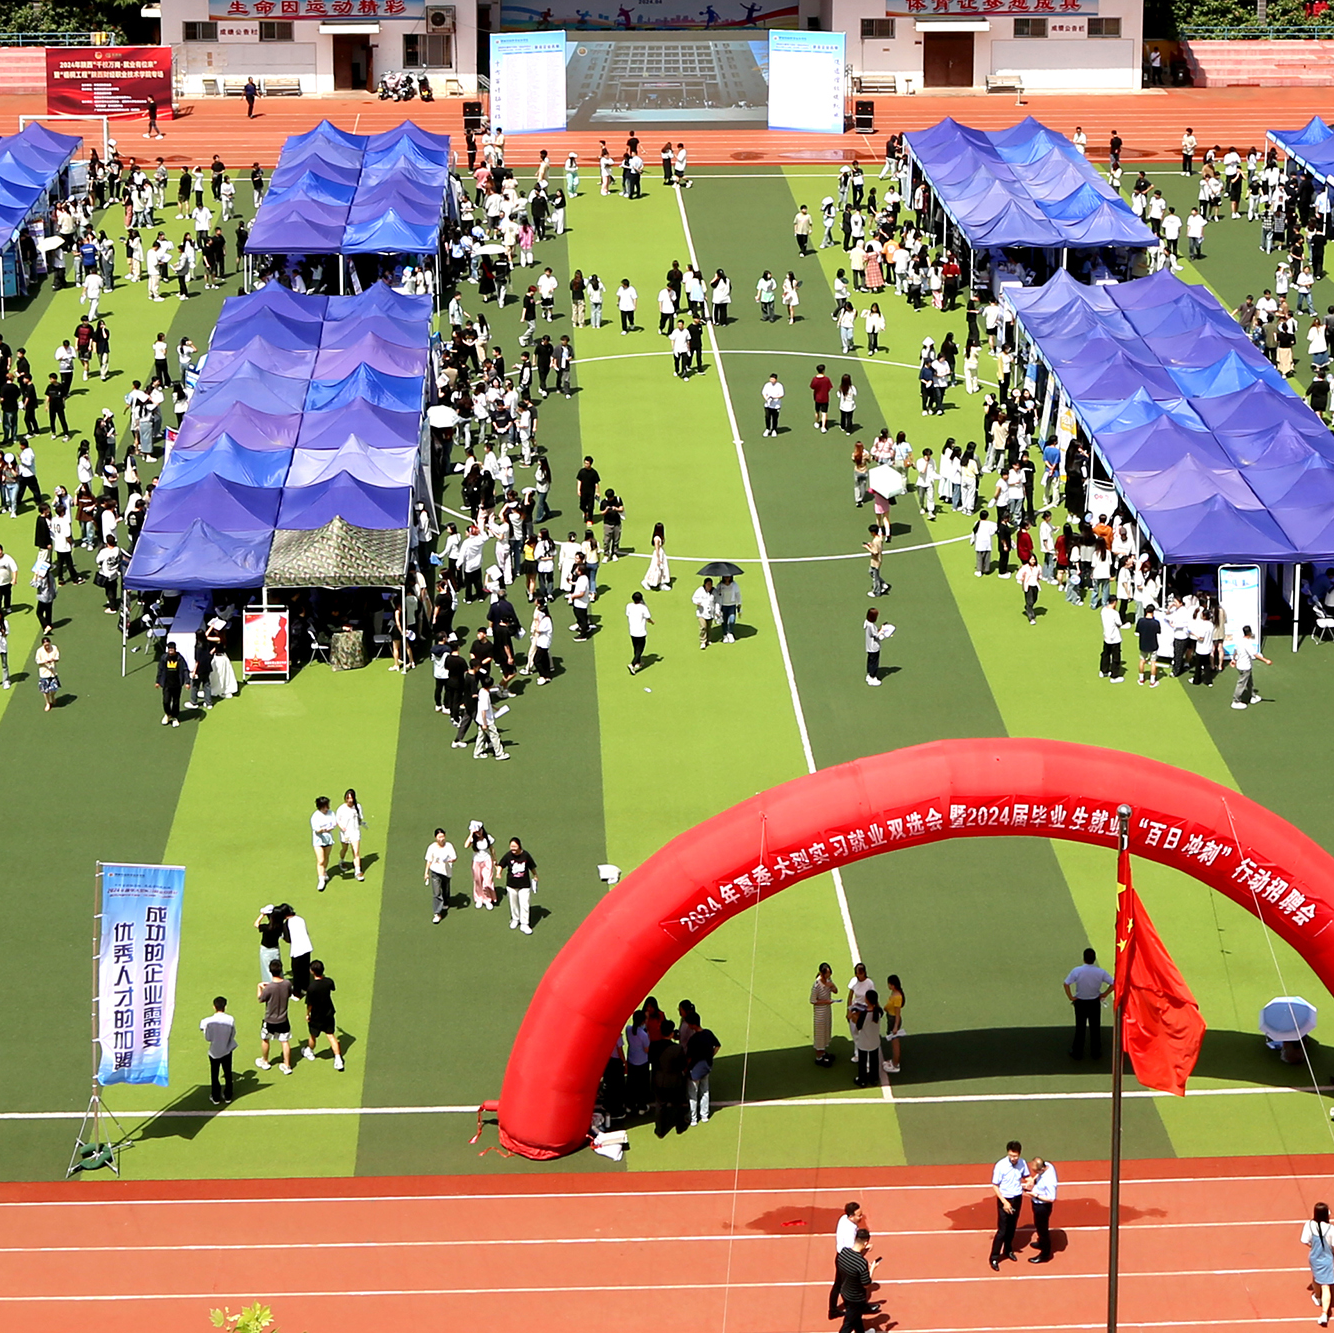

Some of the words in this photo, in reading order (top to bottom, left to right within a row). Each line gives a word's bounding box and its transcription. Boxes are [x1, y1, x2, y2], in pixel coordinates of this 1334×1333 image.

[113, 922, 134, 1071] 优秀人才的加盟
[142, 905, 167, 1050] 成功的企业需要
